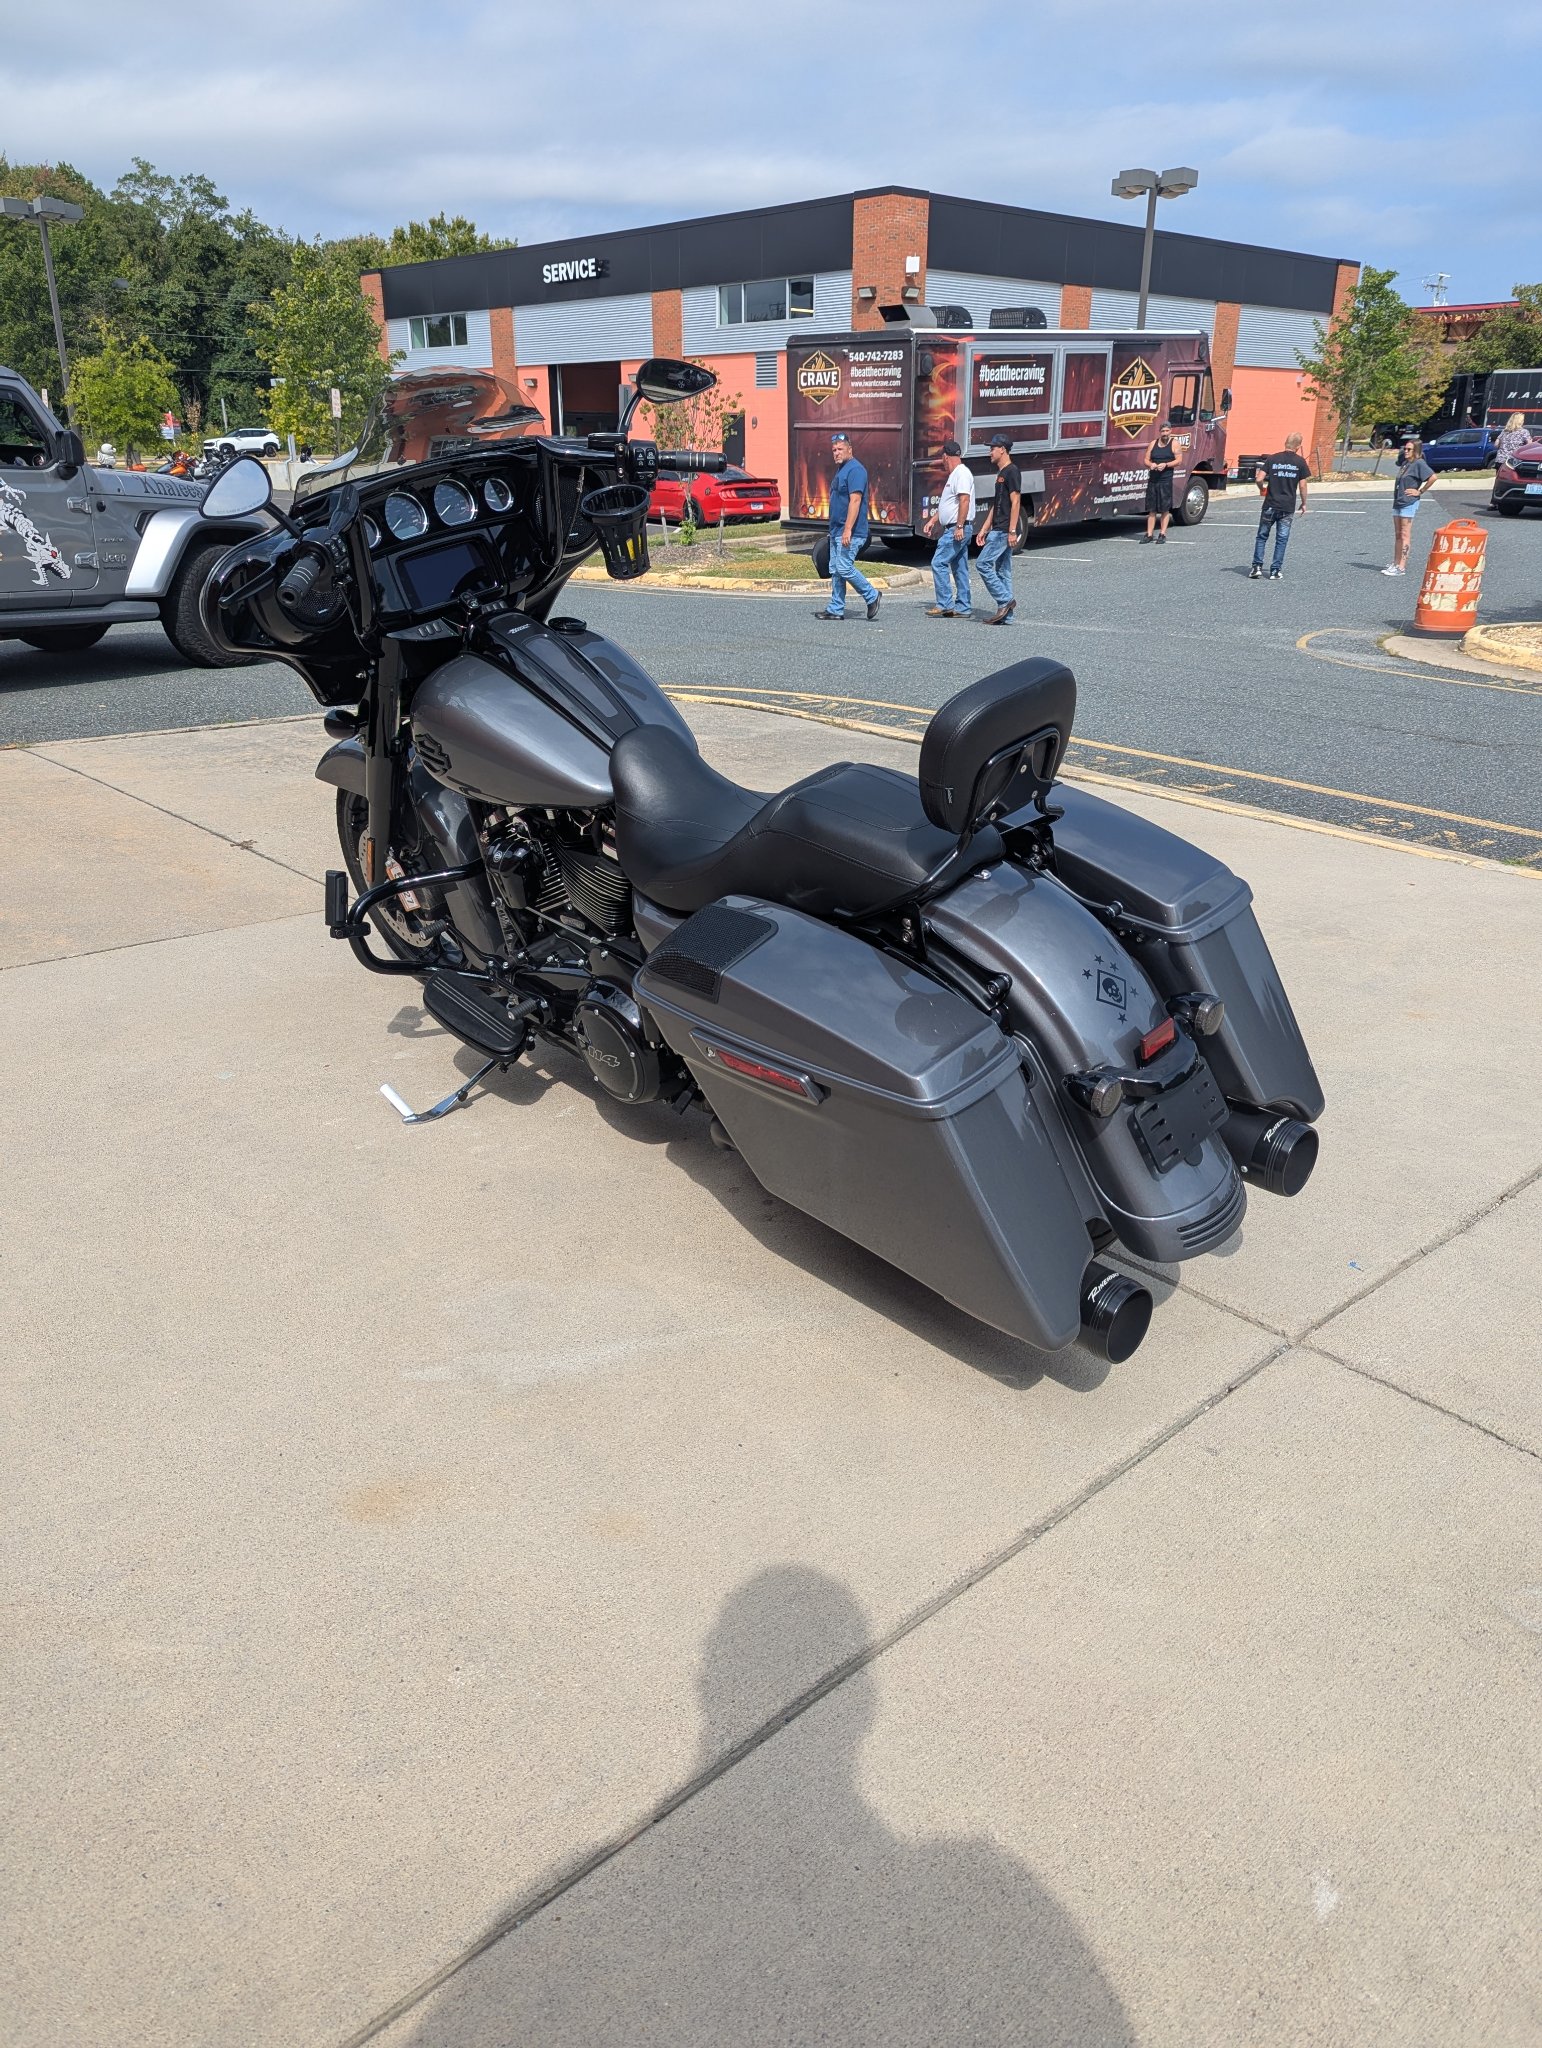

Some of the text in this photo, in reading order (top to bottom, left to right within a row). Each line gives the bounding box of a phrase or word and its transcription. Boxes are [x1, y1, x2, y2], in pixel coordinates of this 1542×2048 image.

[543, 258, 597, 284] SERVICE
[849, 350, 904, 362] 540-742-7283
[800, 371, 838, 387] CRAVE
[851, 364, 902, 379] #beatthecraving
[979, 363, 1046, 384] #beatthecraving
[851, 379, 901, 387] www.iwantcrave.com
[979, 385, 1044, 398] www.iwantcrave.com
[1113, 388, 1158, 412] CRAVE
[1103, 469, 1150, 485] 540-742-728
[102, 552, 127, 564] Jeep
[588, 1045, 620, 1067] 114
